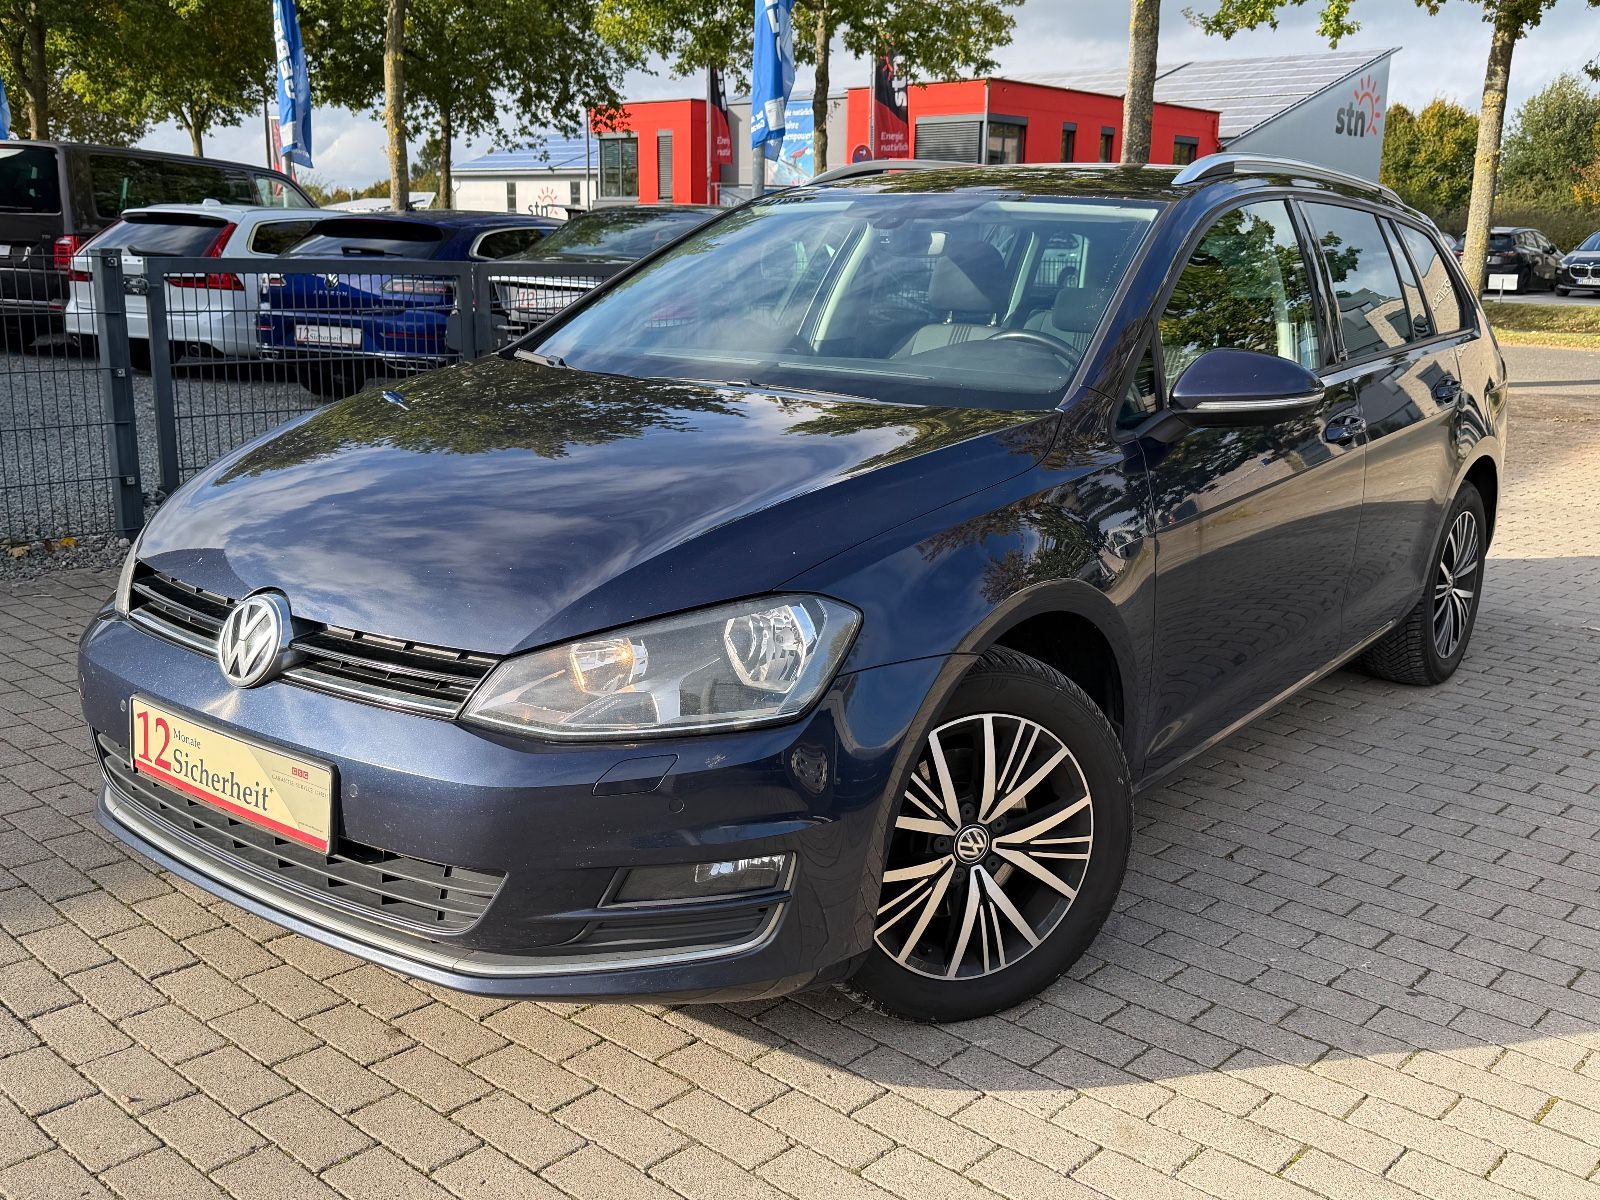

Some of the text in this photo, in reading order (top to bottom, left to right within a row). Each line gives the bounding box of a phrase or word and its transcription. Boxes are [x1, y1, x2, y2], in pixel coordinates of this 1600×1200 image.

[1335, 101, 1366, 138] stn
[528, 201, 548, 217] stn
[219, 595, 283, 688] VW
[136, 710, 172, 772] 12
[172, 727, 201, 750] Monate
[957, 827, 987, 861] VW
